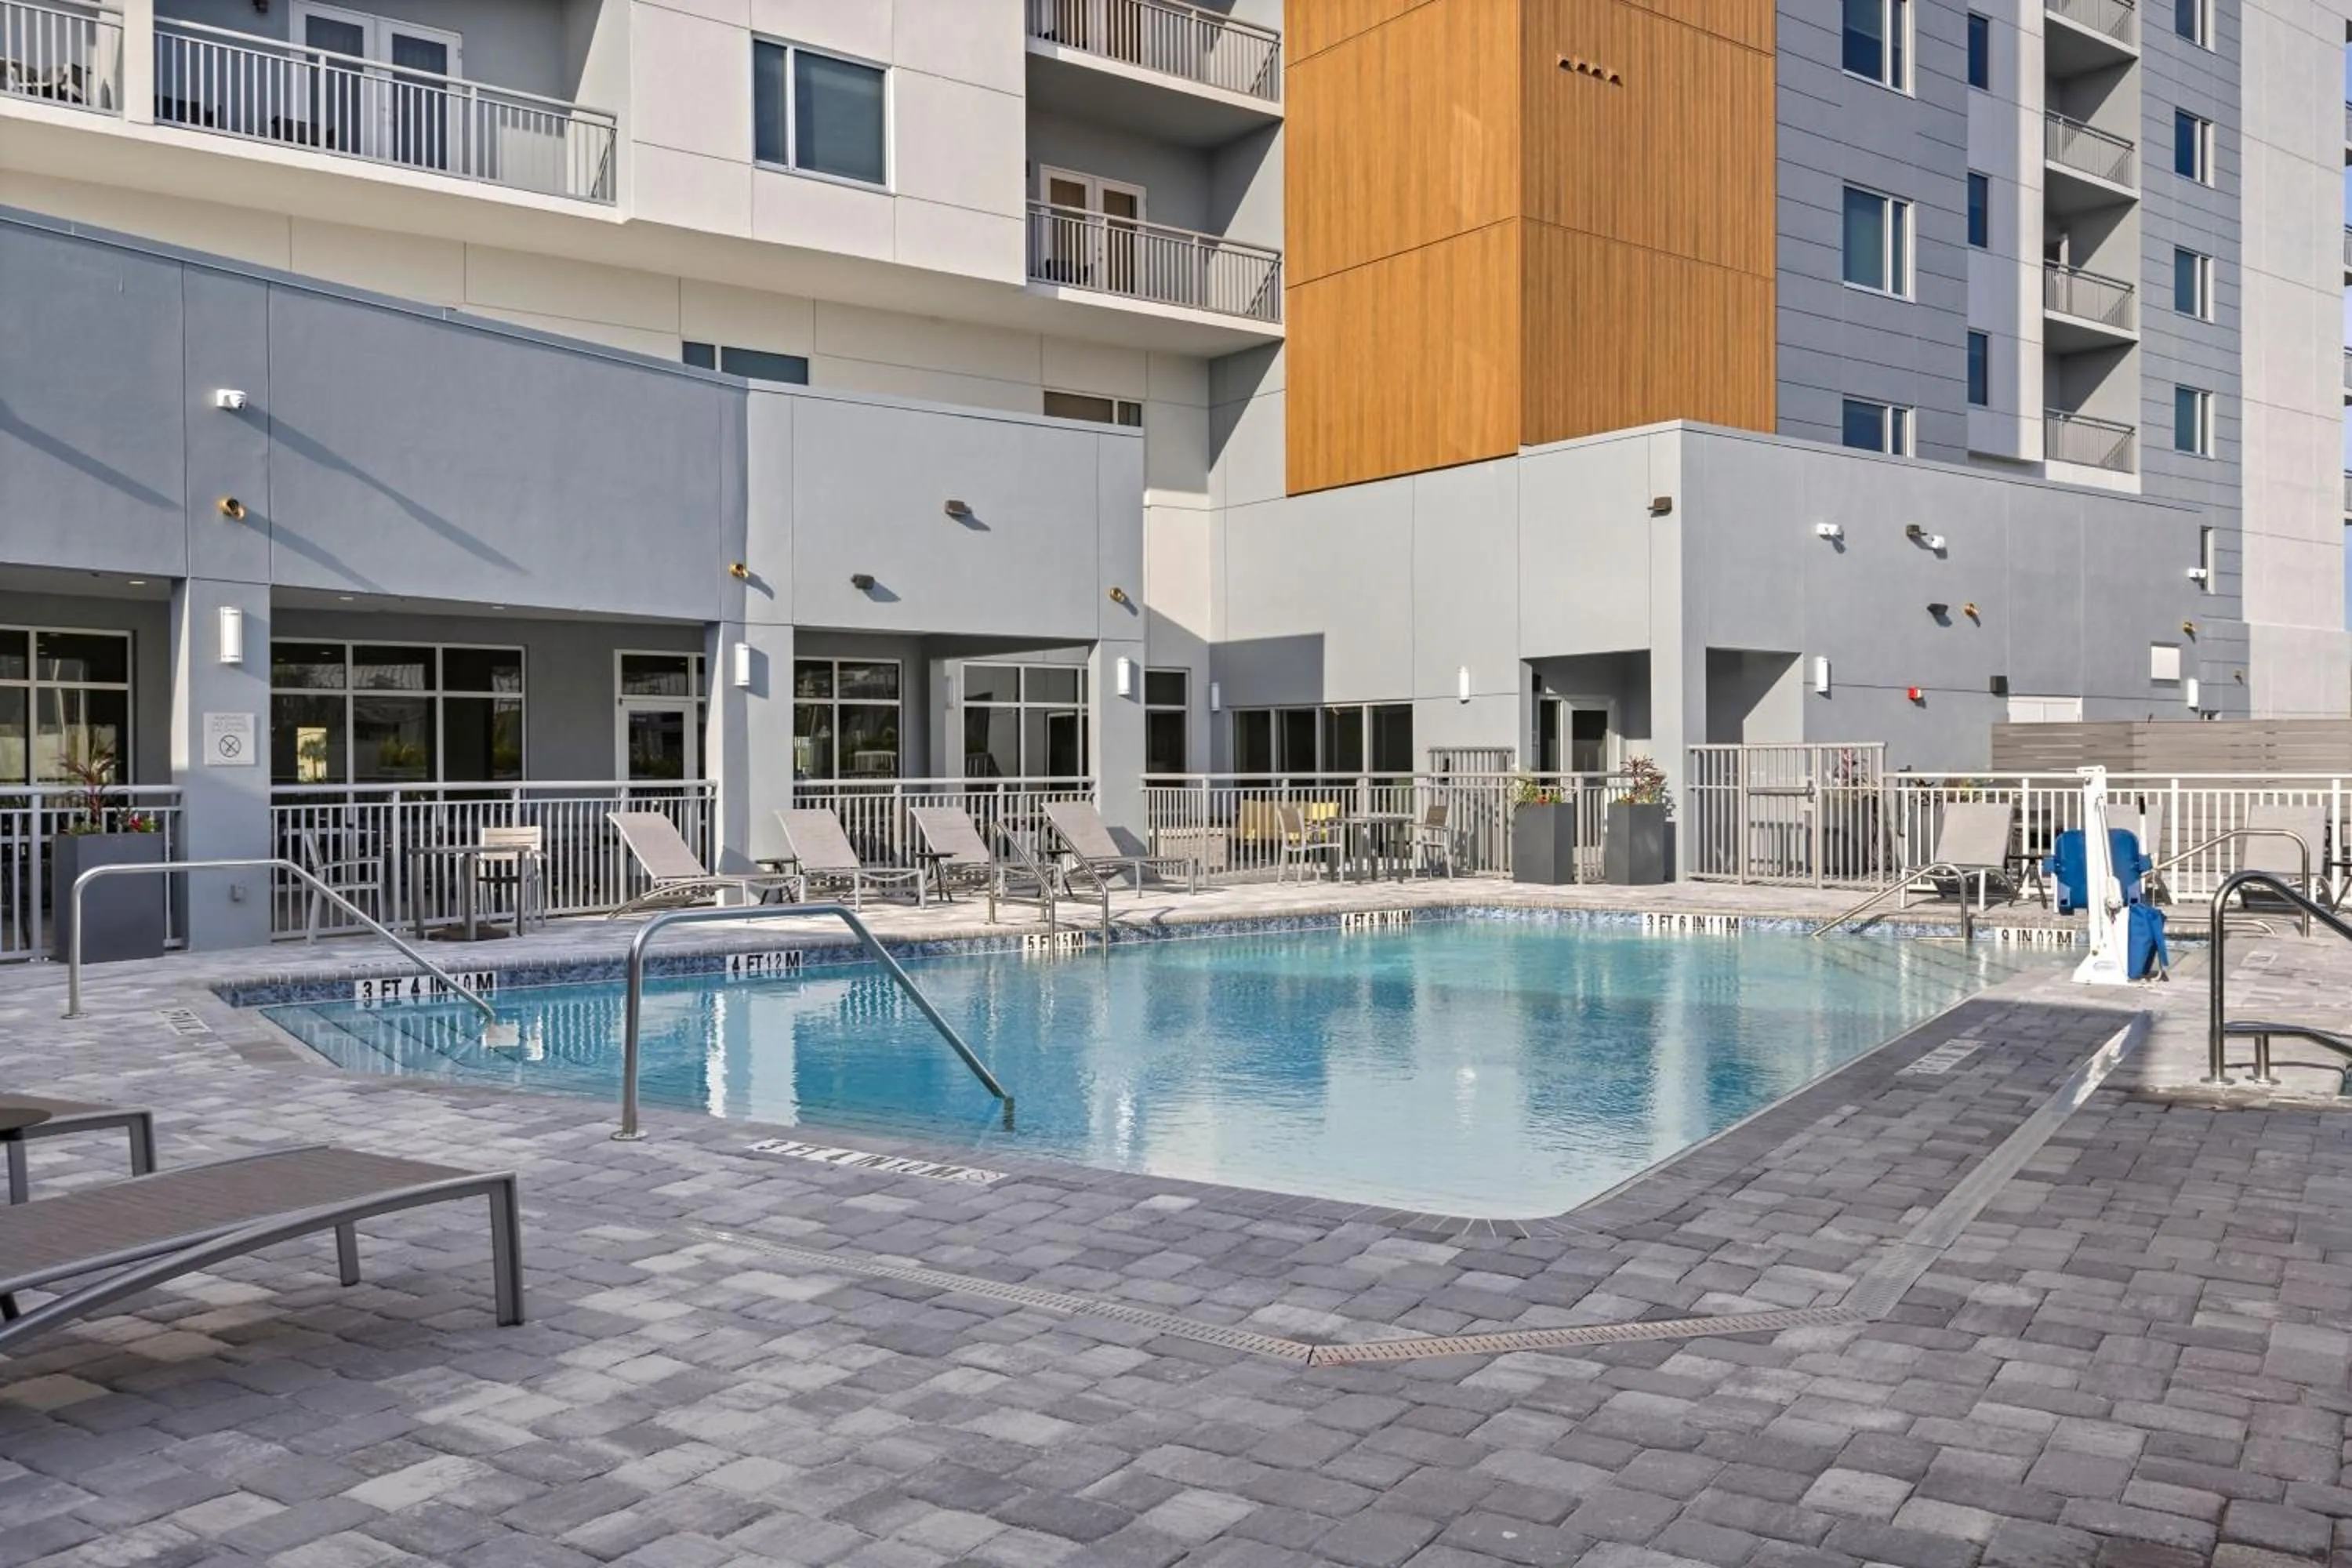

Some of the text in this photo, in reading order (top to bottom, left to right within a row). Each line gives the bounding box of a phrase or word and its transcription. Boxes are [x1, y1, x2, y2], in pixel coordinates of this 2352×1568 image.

[1354, 913, 1365, 926] FT
[1659, 914, 1674, 927] FT
[1693, 915, 1705, 927] IN
[1726, 916, 1739, 929] M
[1071, 933, 1083, 946] M
[2016, 929, 2032, 942] IN
[2056, 931, 2072, 942] M
[732, 955, 740, 971] 4
[746, 954, 764, 971] FT
[786, 951, 800, 967] M
[363, 981, 372, 998] 3
[381, 978, 402, 997] FT
[410, 977, 420, 994] 4
[430, 975, 448, 993] IN
[476, 972, 493, 990] M
